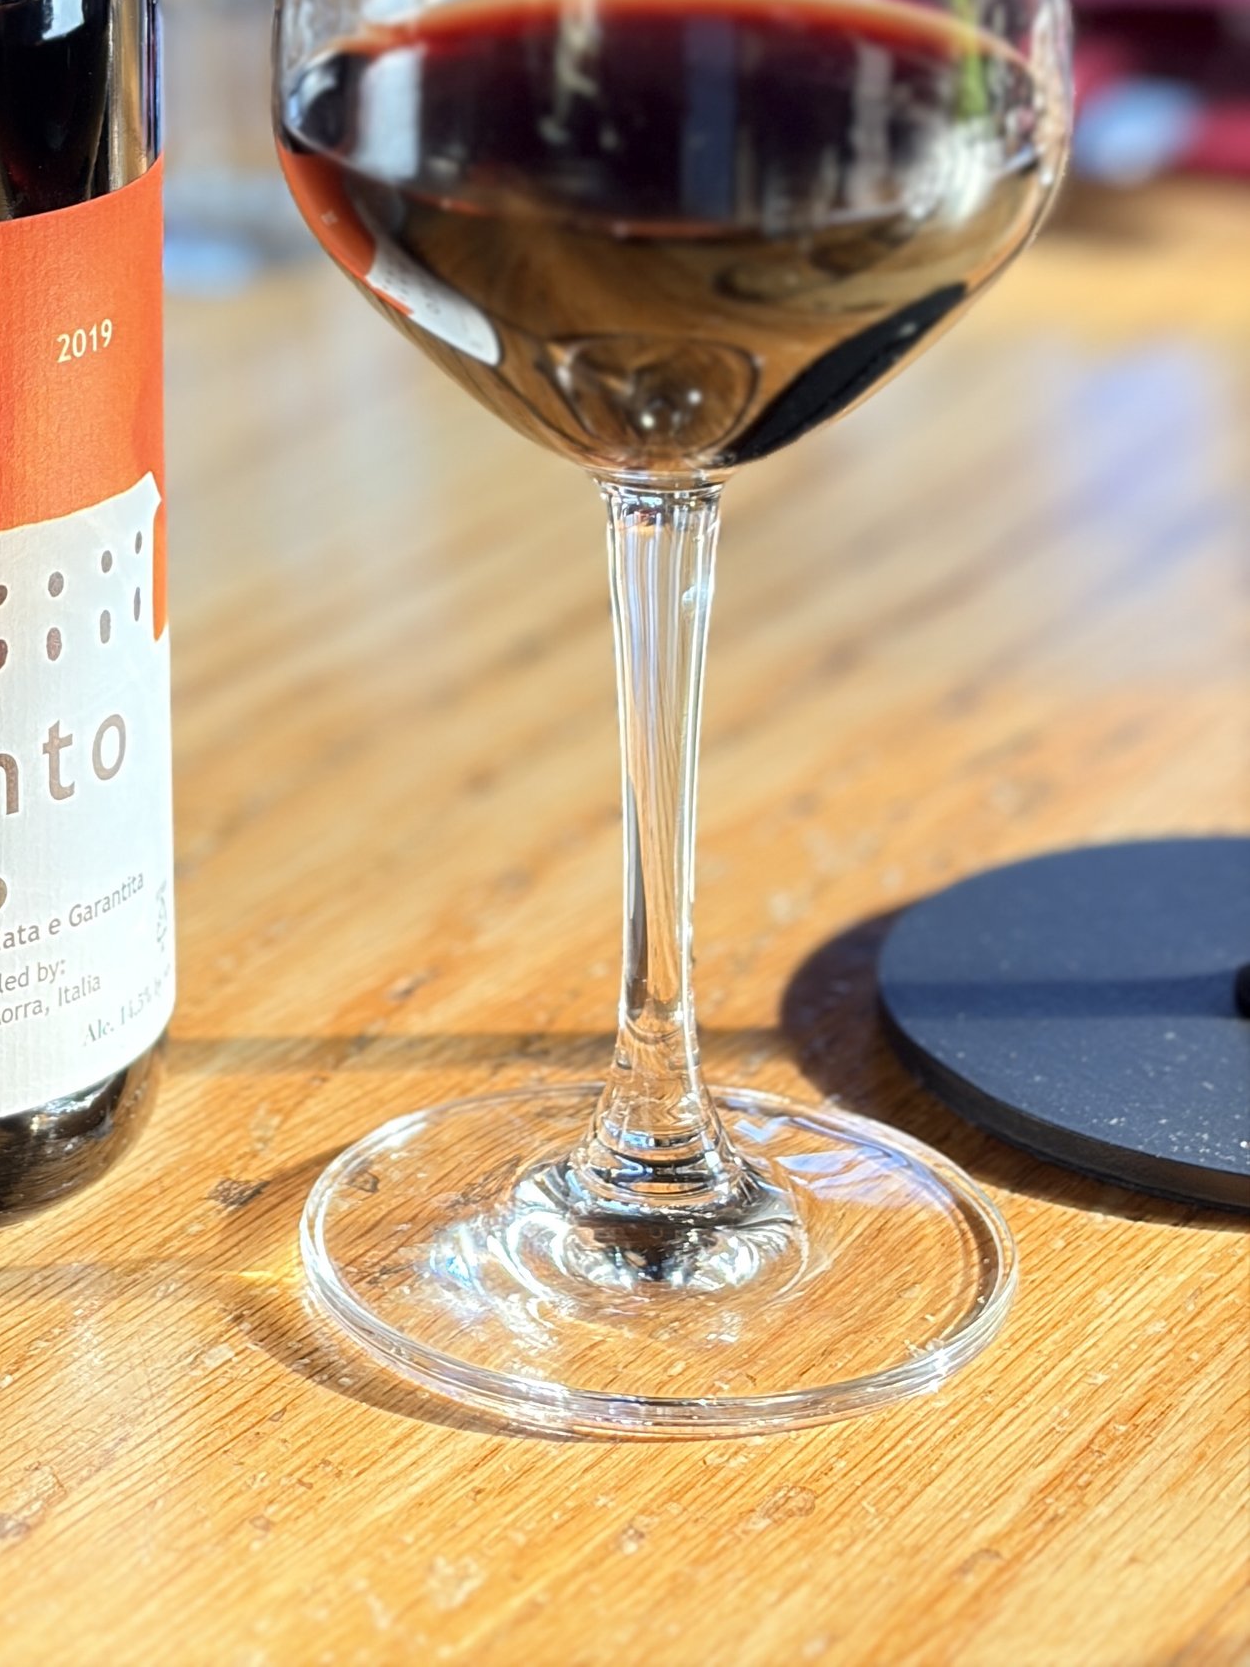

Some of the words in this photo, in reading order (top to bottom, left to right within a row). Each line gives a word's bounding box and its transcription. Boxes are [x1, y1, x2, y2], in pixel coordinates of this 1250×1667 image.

[56, 318, 114, 364] 2019
[48, 917, 62, 935] e
[68, 872, 145, 928] Garantita
[37, 958, 66, 984] by:
[58, 974, 101, 1007] Italia
